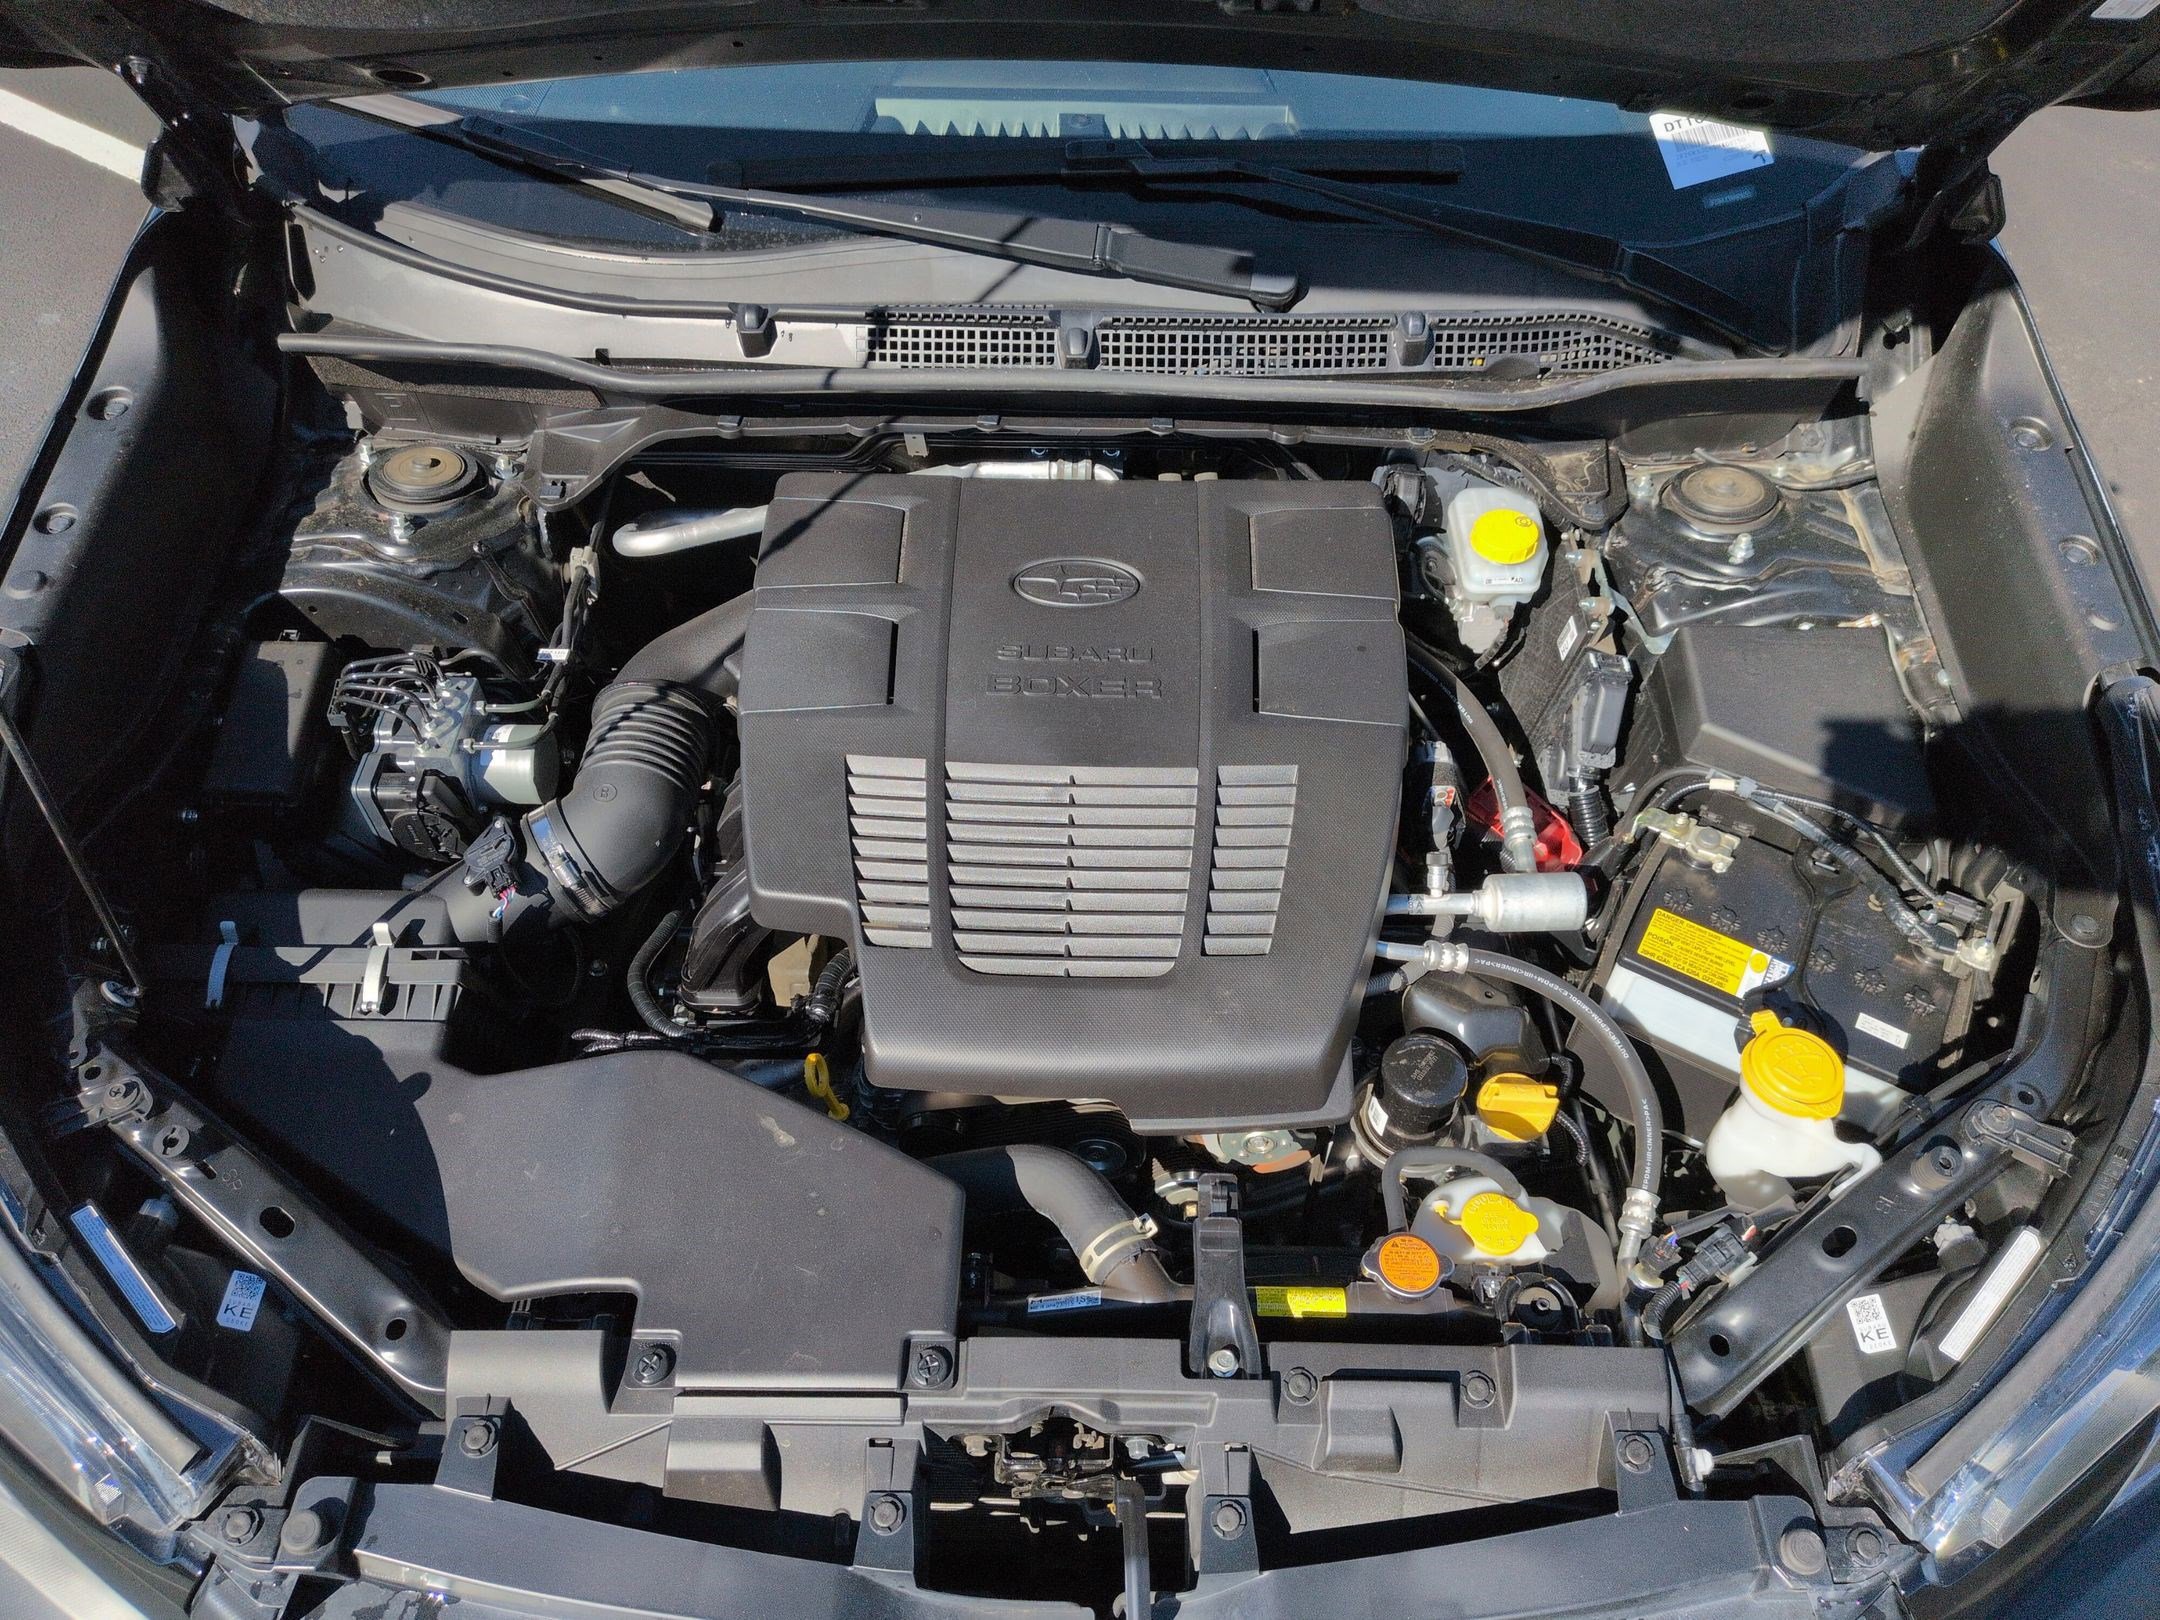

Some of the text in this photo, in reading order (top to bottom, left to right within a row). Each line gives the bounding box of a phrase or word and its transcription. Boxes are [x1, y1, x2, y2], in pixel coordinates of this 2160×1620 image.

[998, 645, 1153, 662] SUBARU
[986, 676, 1162, 698] BOXER
[1656, 911, 1684, 925] DANGER
[1647, 931, 1674, 947] POISON
[224, 1304, 253, 1319] KE
[1861, 1328, 1889, 1342] KE
